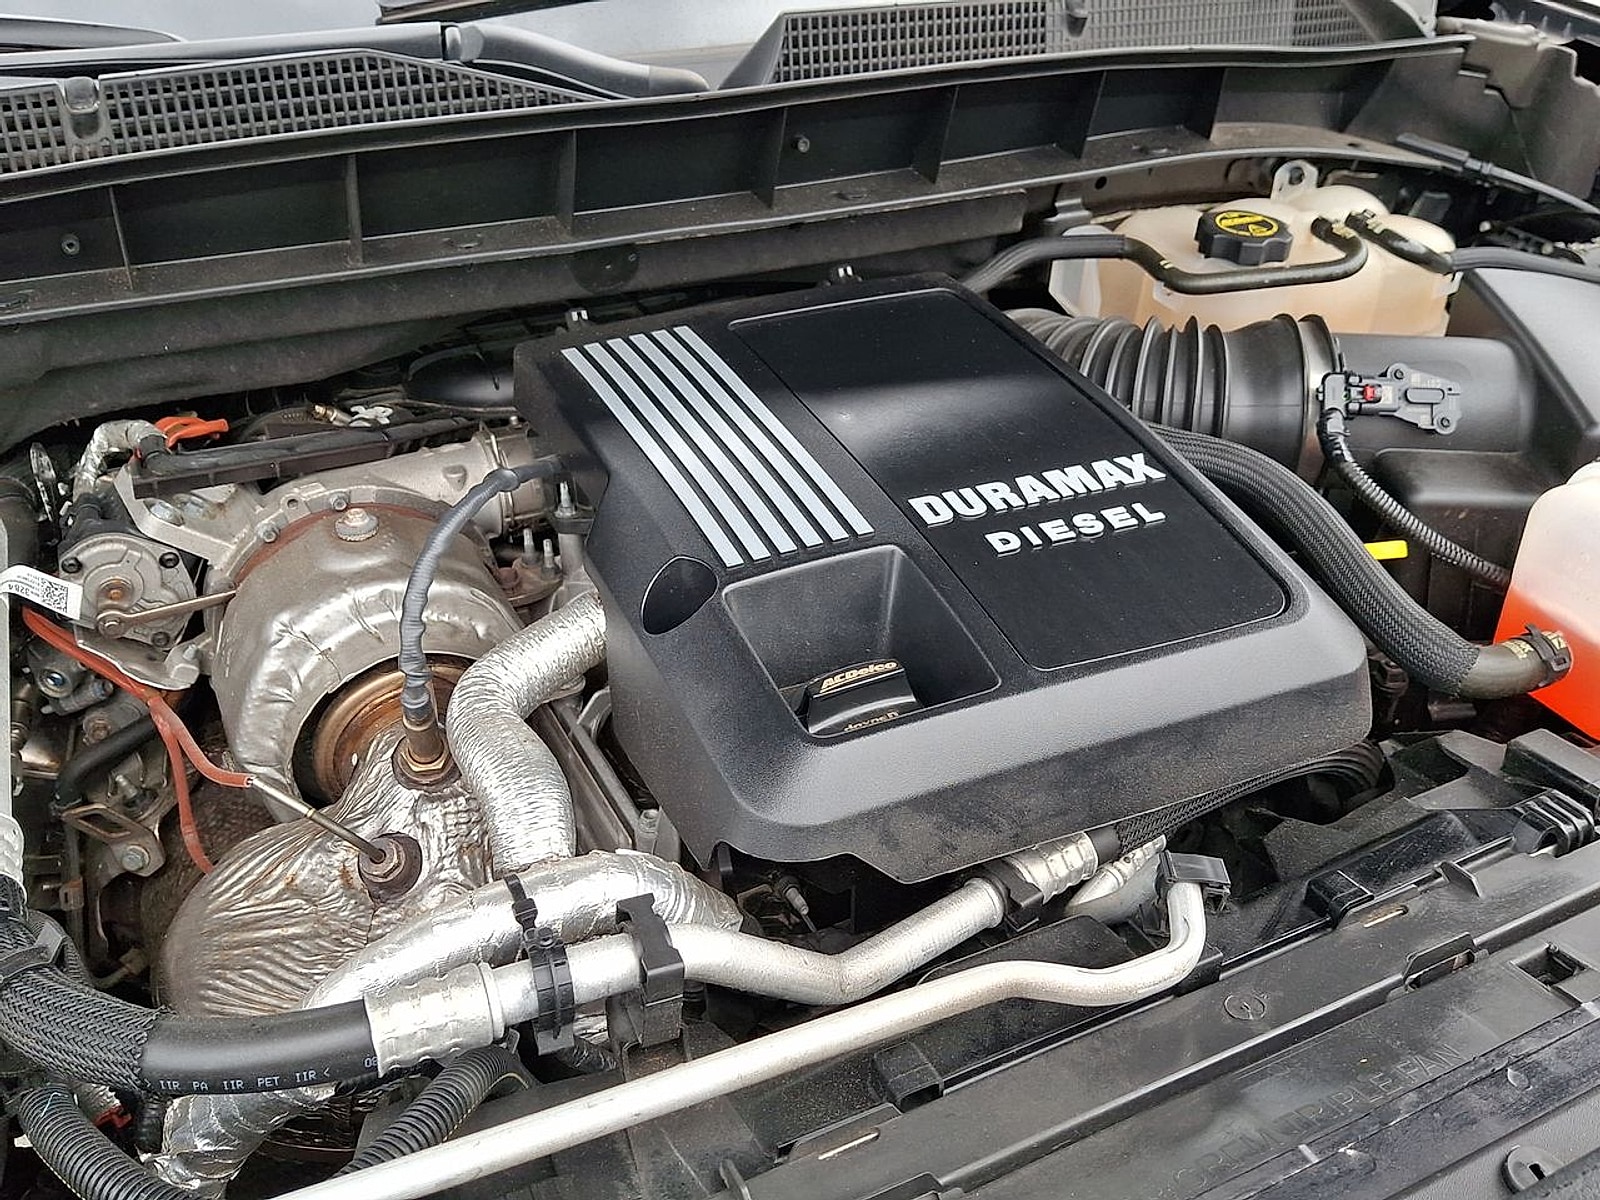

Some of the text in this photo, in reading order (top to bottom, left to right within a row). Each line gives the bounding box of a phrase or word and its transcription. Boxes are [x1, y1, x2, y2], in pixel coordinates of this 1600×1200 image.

[908, 453, 1166, 527] DURAMAX
[985, 502, 1166, 557] DIESEL
[820, 662, 898, 692] ACDelco
[159, 1080, 180, 1091] IIR
[192, 1081, 208, 1091] PA
[222, 1080, 244, 1091] IIR
[257, 1076, 280, 1088] PET
[295, 1069, 317, 1083] IIR
